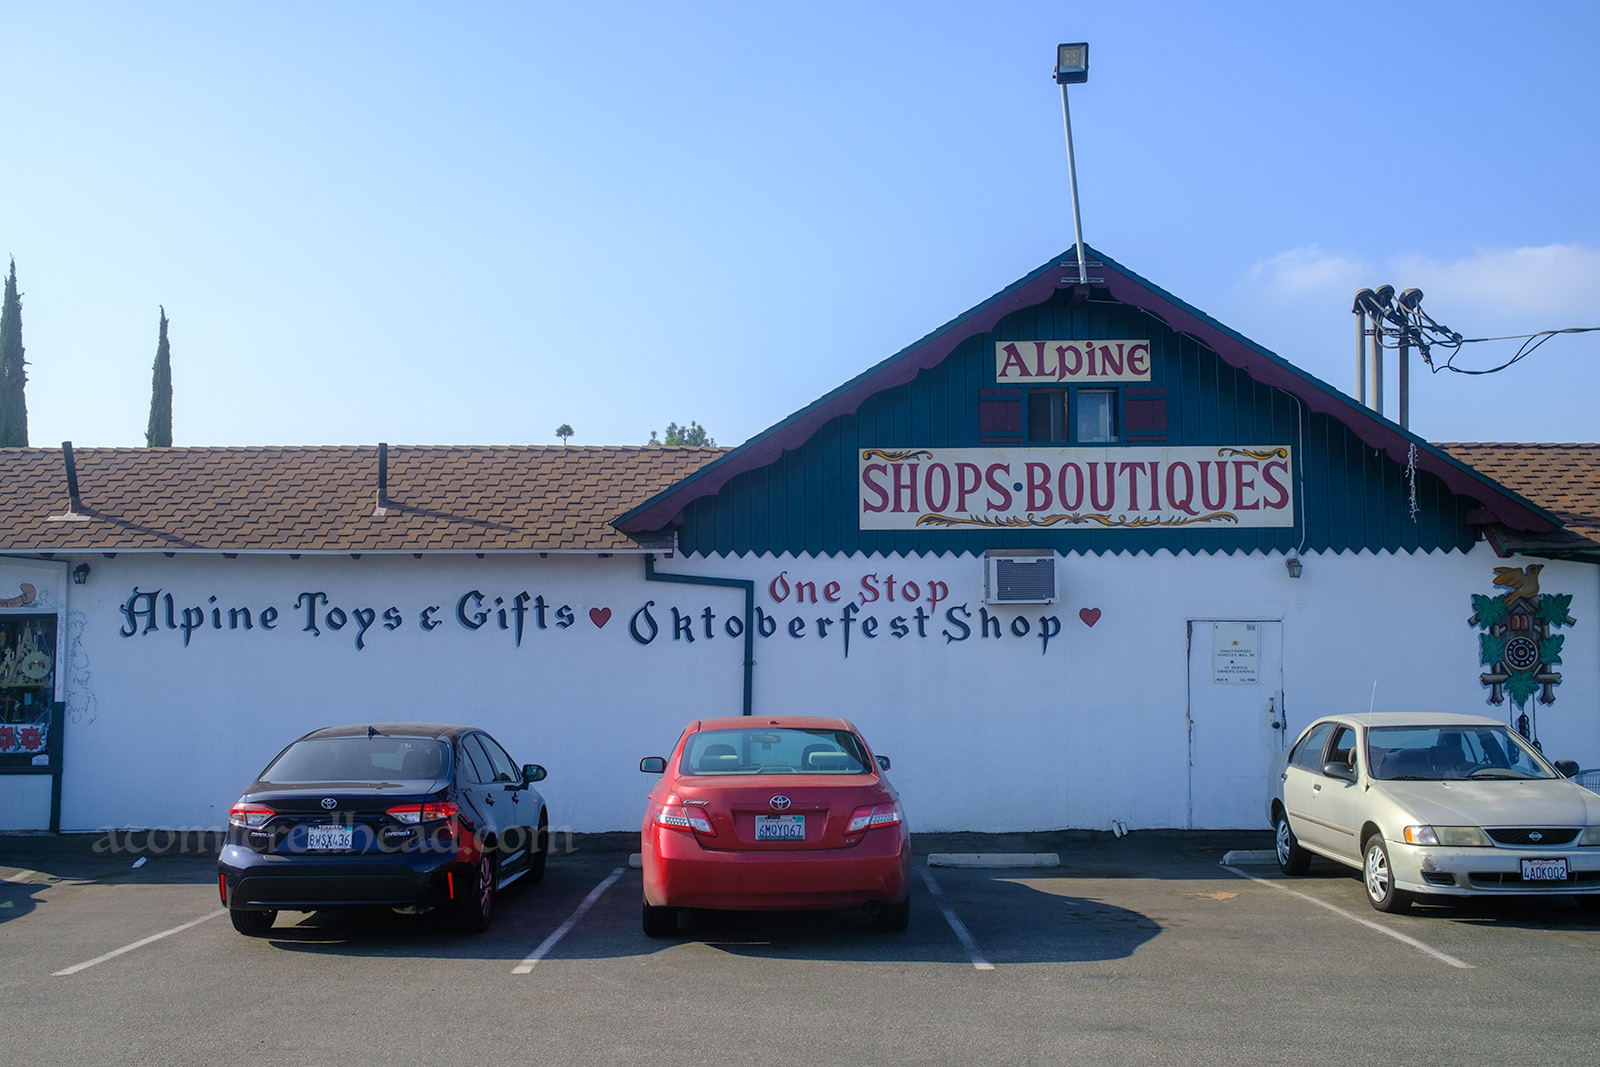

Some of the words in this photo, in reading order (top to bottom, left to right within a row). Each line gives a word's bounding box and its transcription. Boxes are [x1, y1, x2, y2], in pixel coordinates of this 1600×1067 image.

[861, 462, 1013, 514] SHOPS
[1026, 459, 1290, 516] BOUTIQUES
[119, 585, 279, 648] Alpine
[293, 591, 403, 652] Toys
[455, 589, 576, 648] Gifts
[769, 570, 841, 604] One
[859, 572, 949, 614] Stop
[628, 600, 931, 660] Oktoberfest
[943, 602, 1063, 655] Shop
[309, 833, 350, 847] 8WSX436
